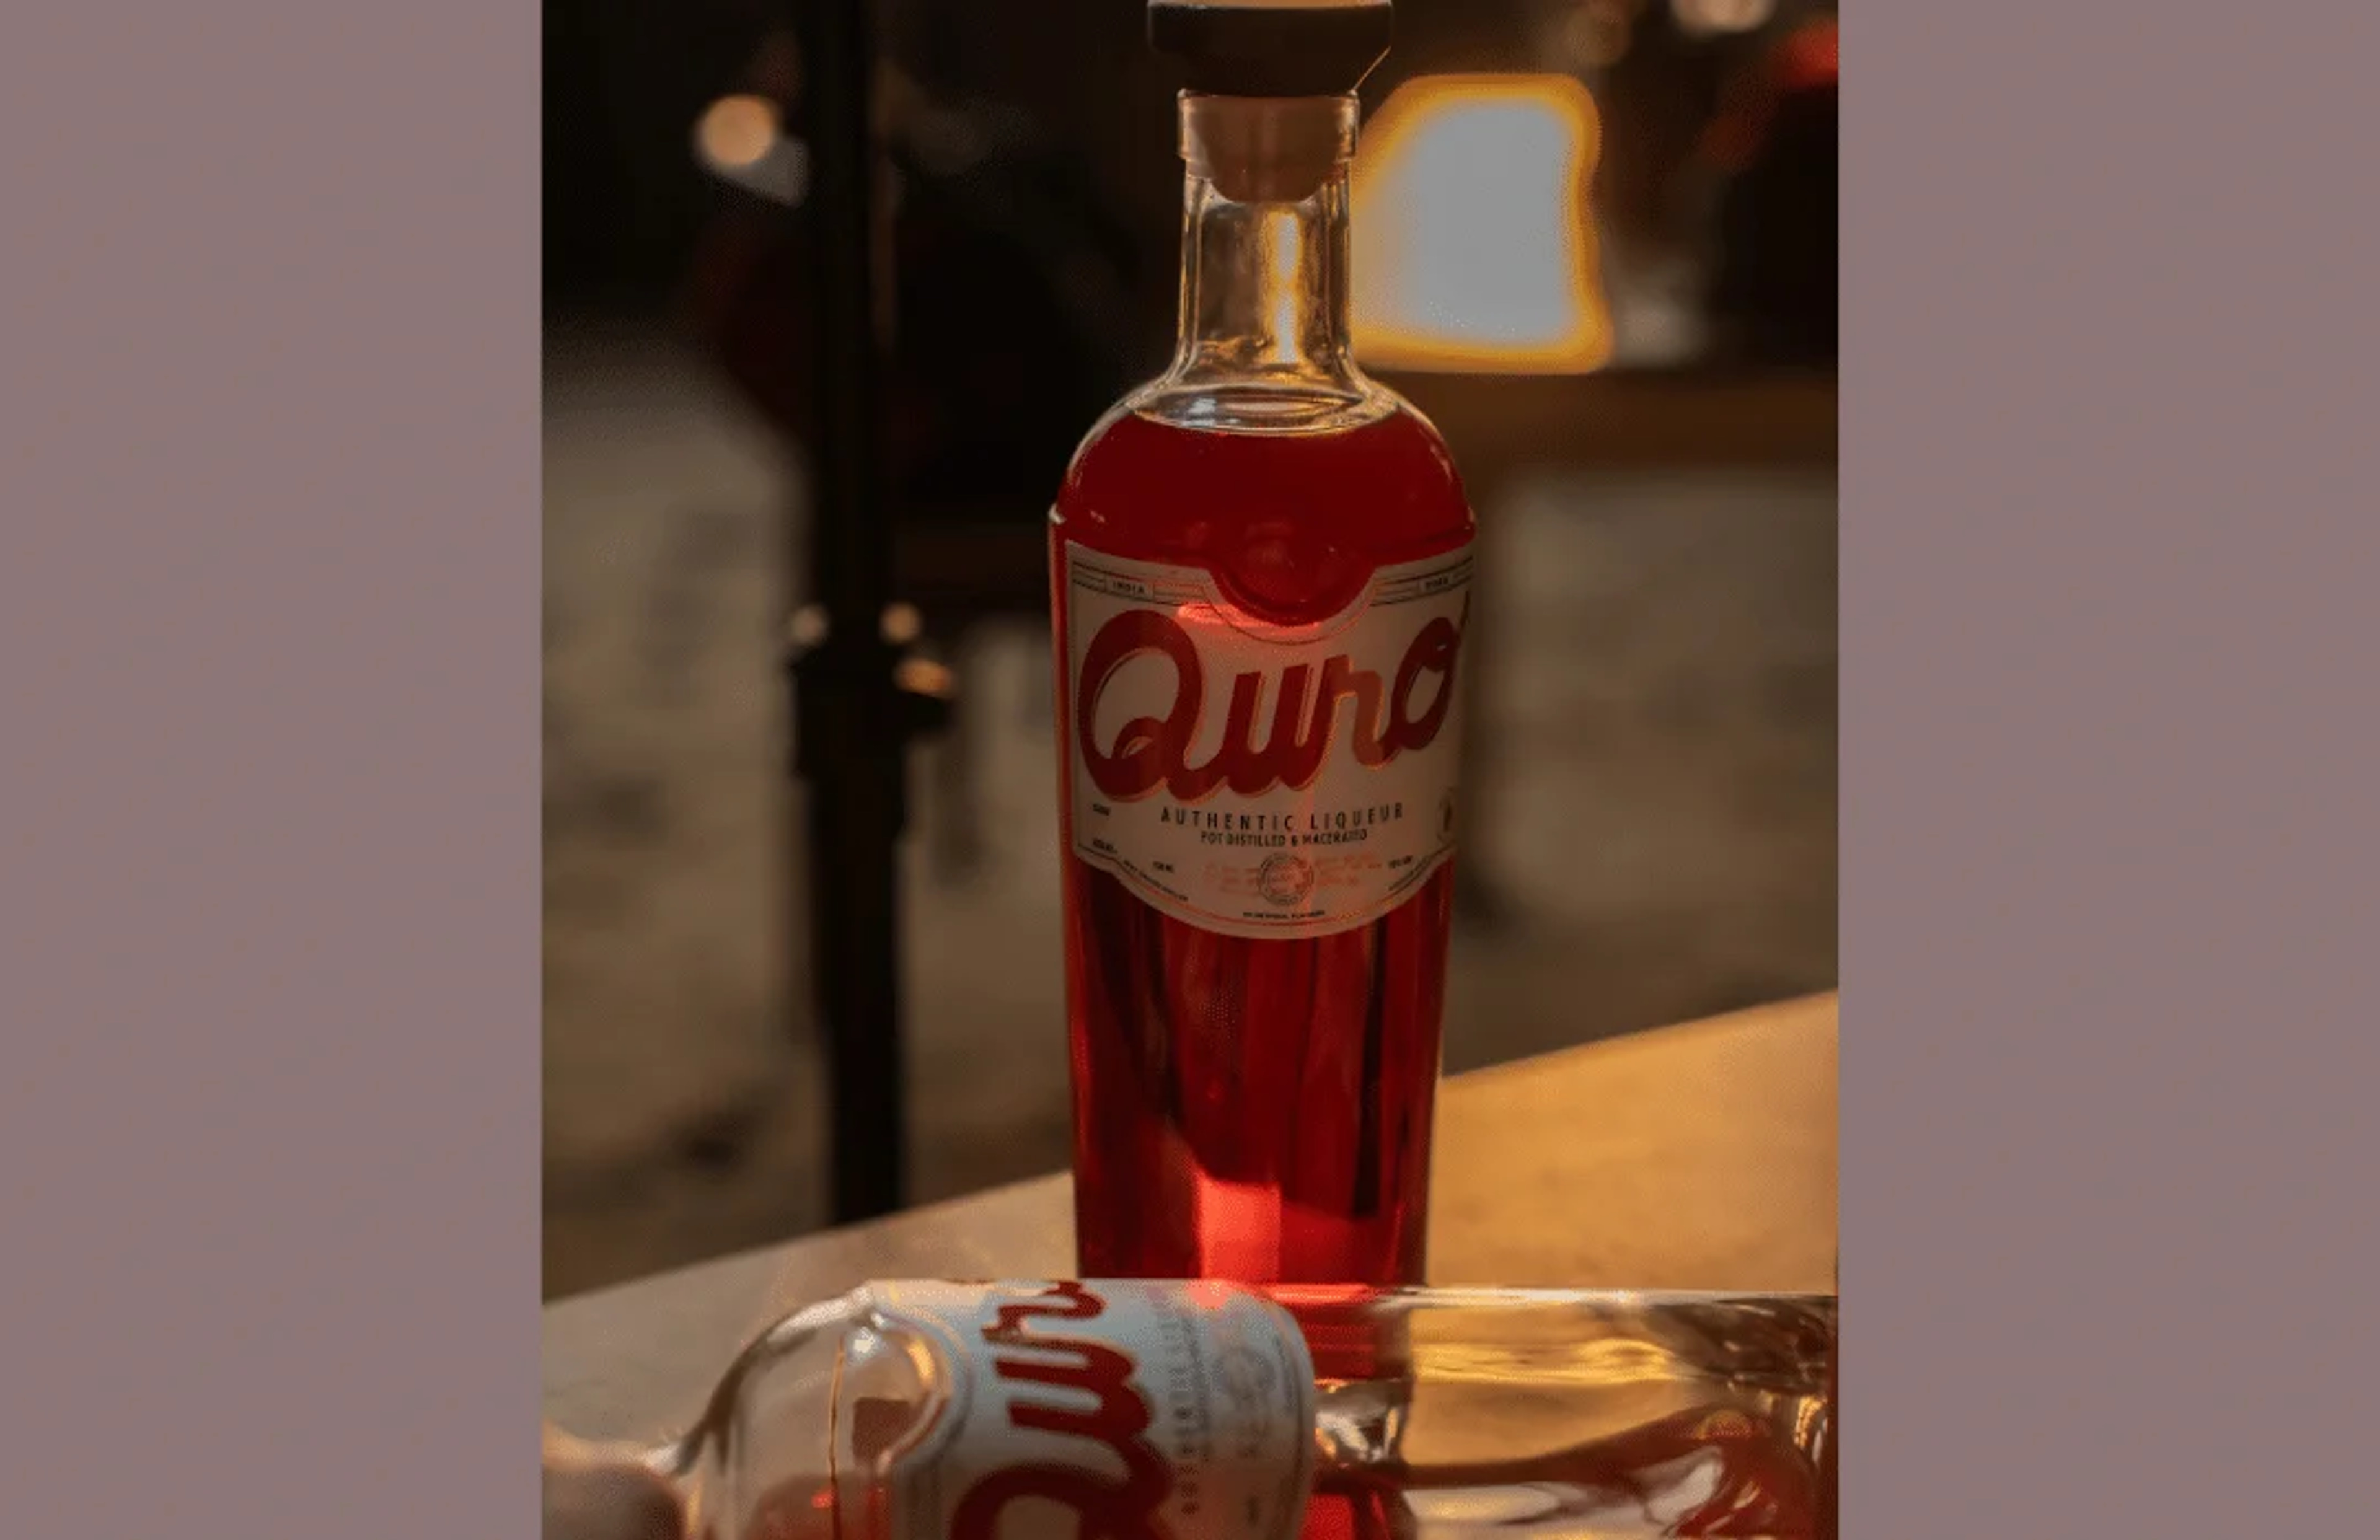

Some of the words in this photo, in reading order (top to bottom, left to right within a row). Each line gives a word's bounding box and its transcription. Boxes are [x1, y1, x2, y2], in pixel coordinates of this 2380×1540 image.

[1161, 806, 1294, 832] AUTHENTIC
[1310, 802, 1403, 830] LIQUEUR
[1201, 831, 1223, 845] POT
[1226, 832, 1286, 847] DISTILLED
[1302, 828, 1367, 846] MACERATED
